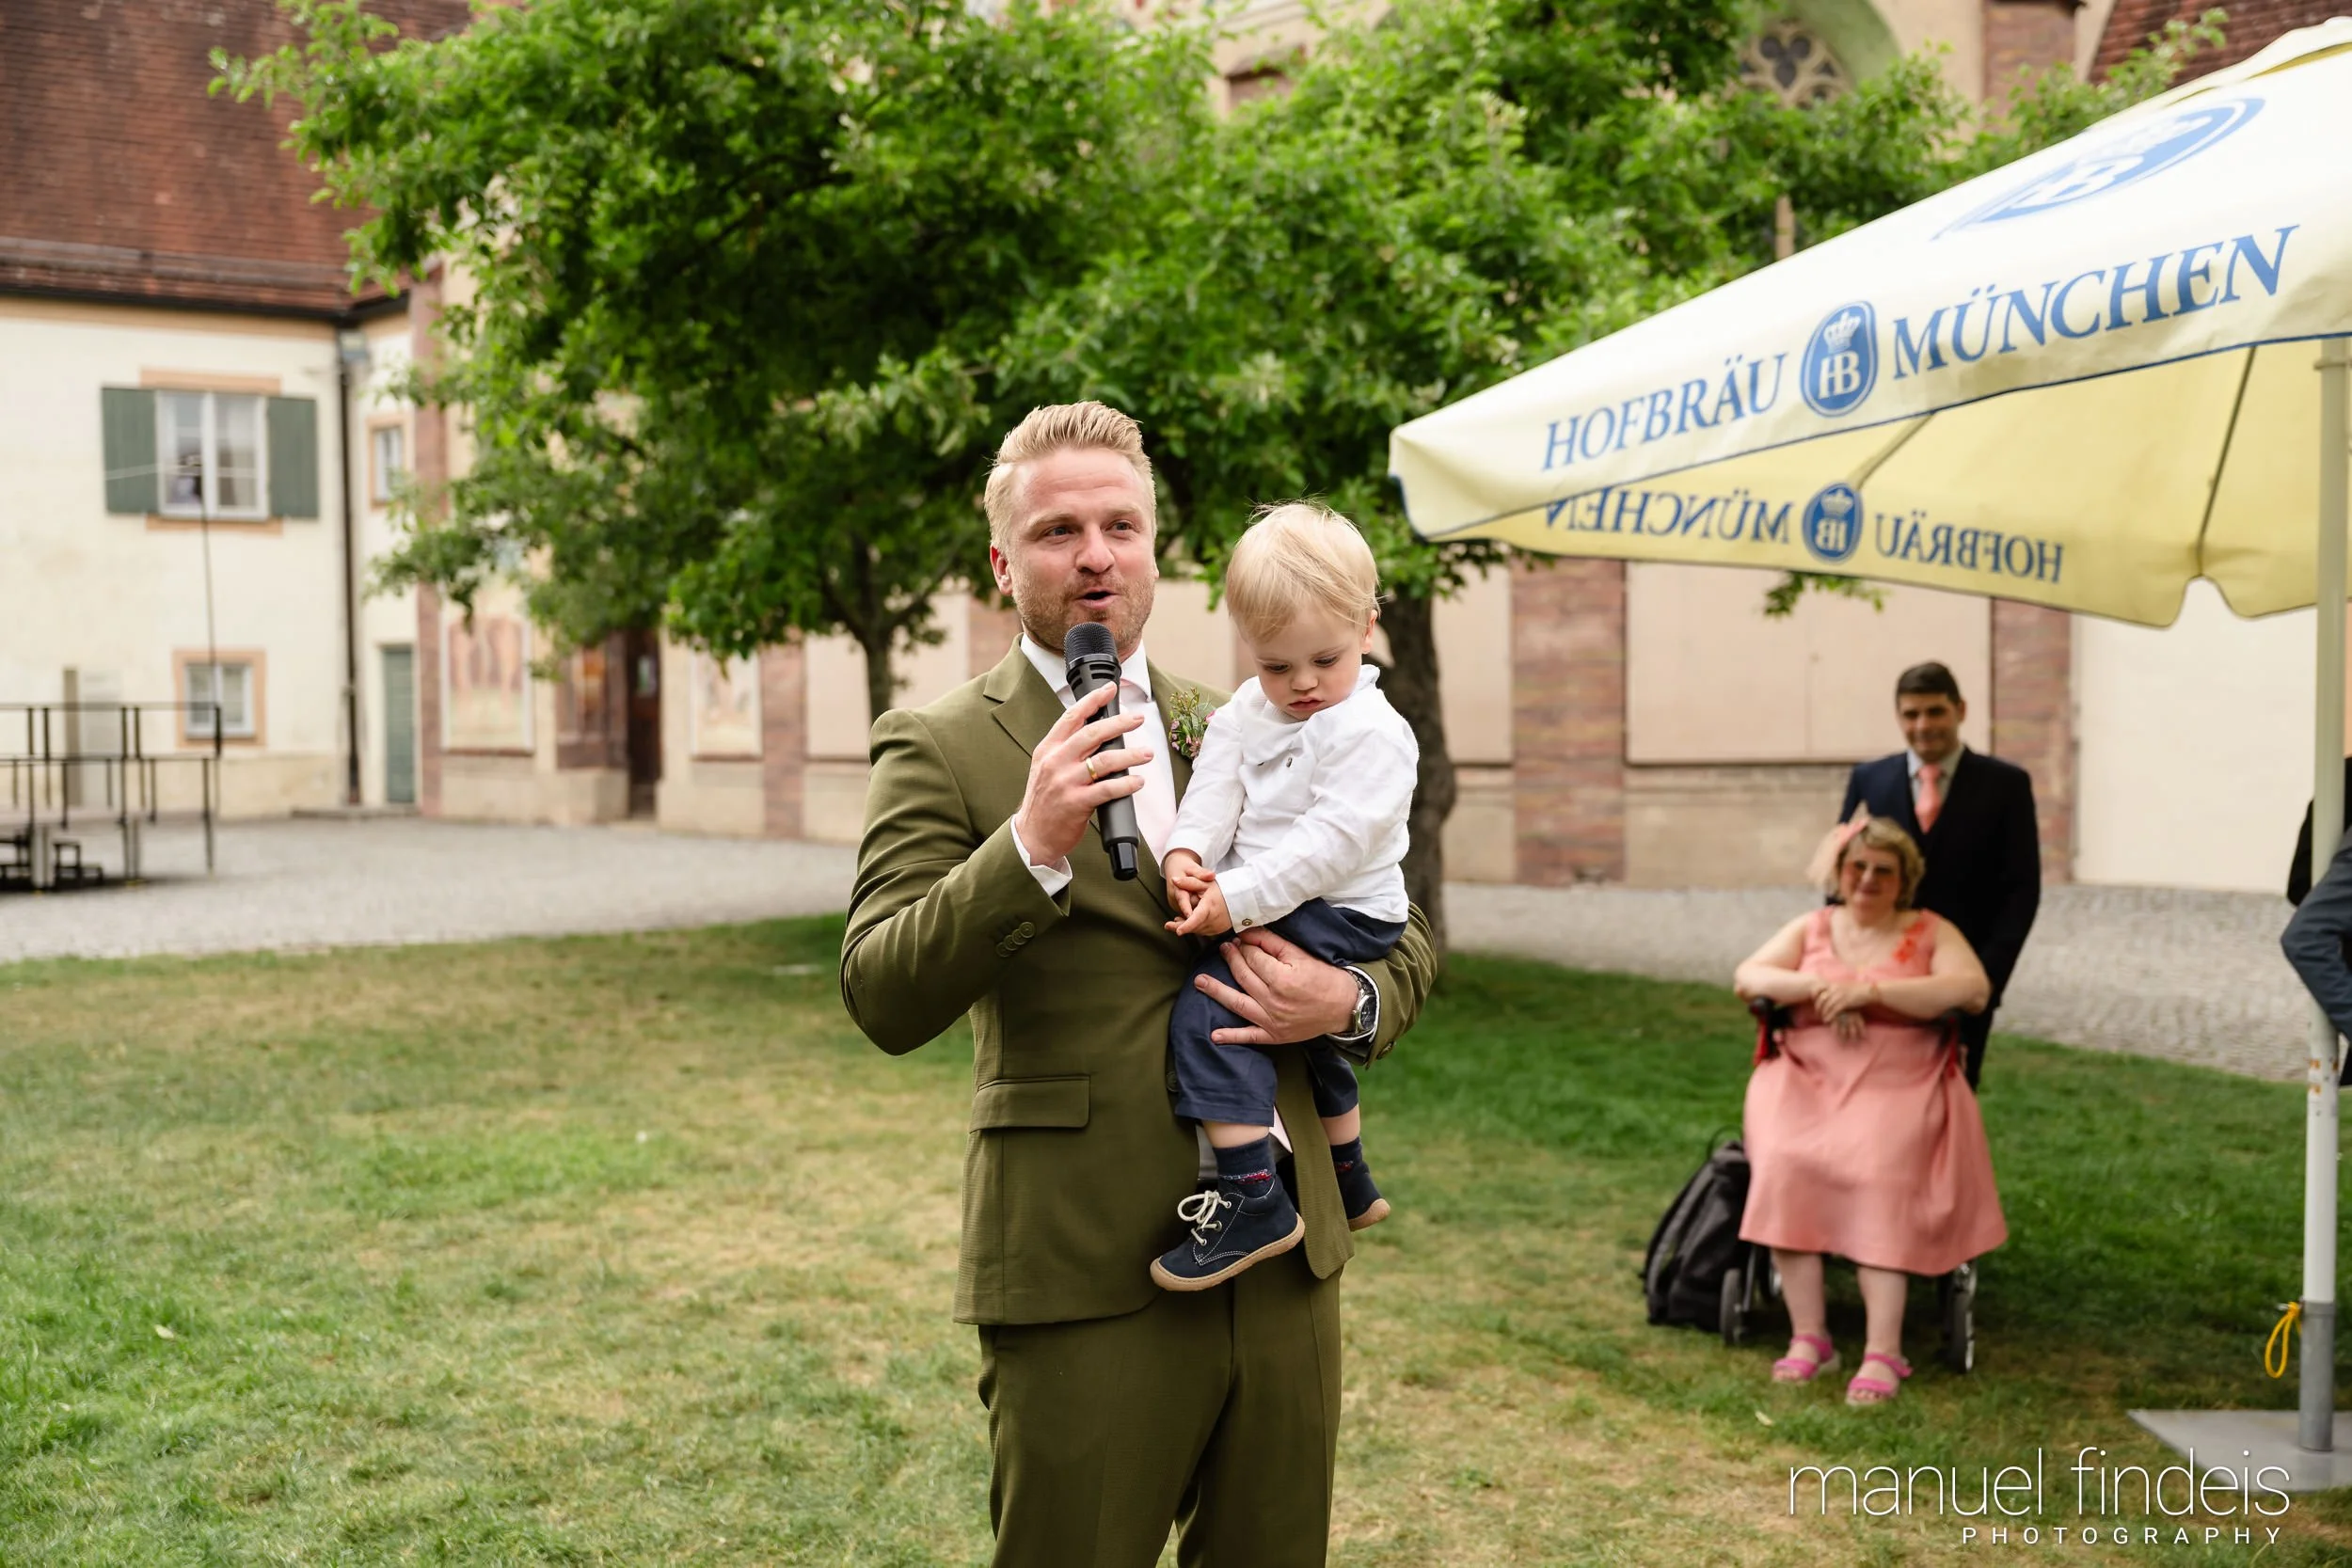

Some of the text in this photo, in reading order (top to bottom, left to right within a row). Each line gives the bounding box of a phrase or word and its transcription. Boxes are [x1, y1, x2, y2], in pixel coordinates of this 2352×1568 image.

[1541, 224, 2300, 471] HOFBRÄU HB MÜNCHEN
